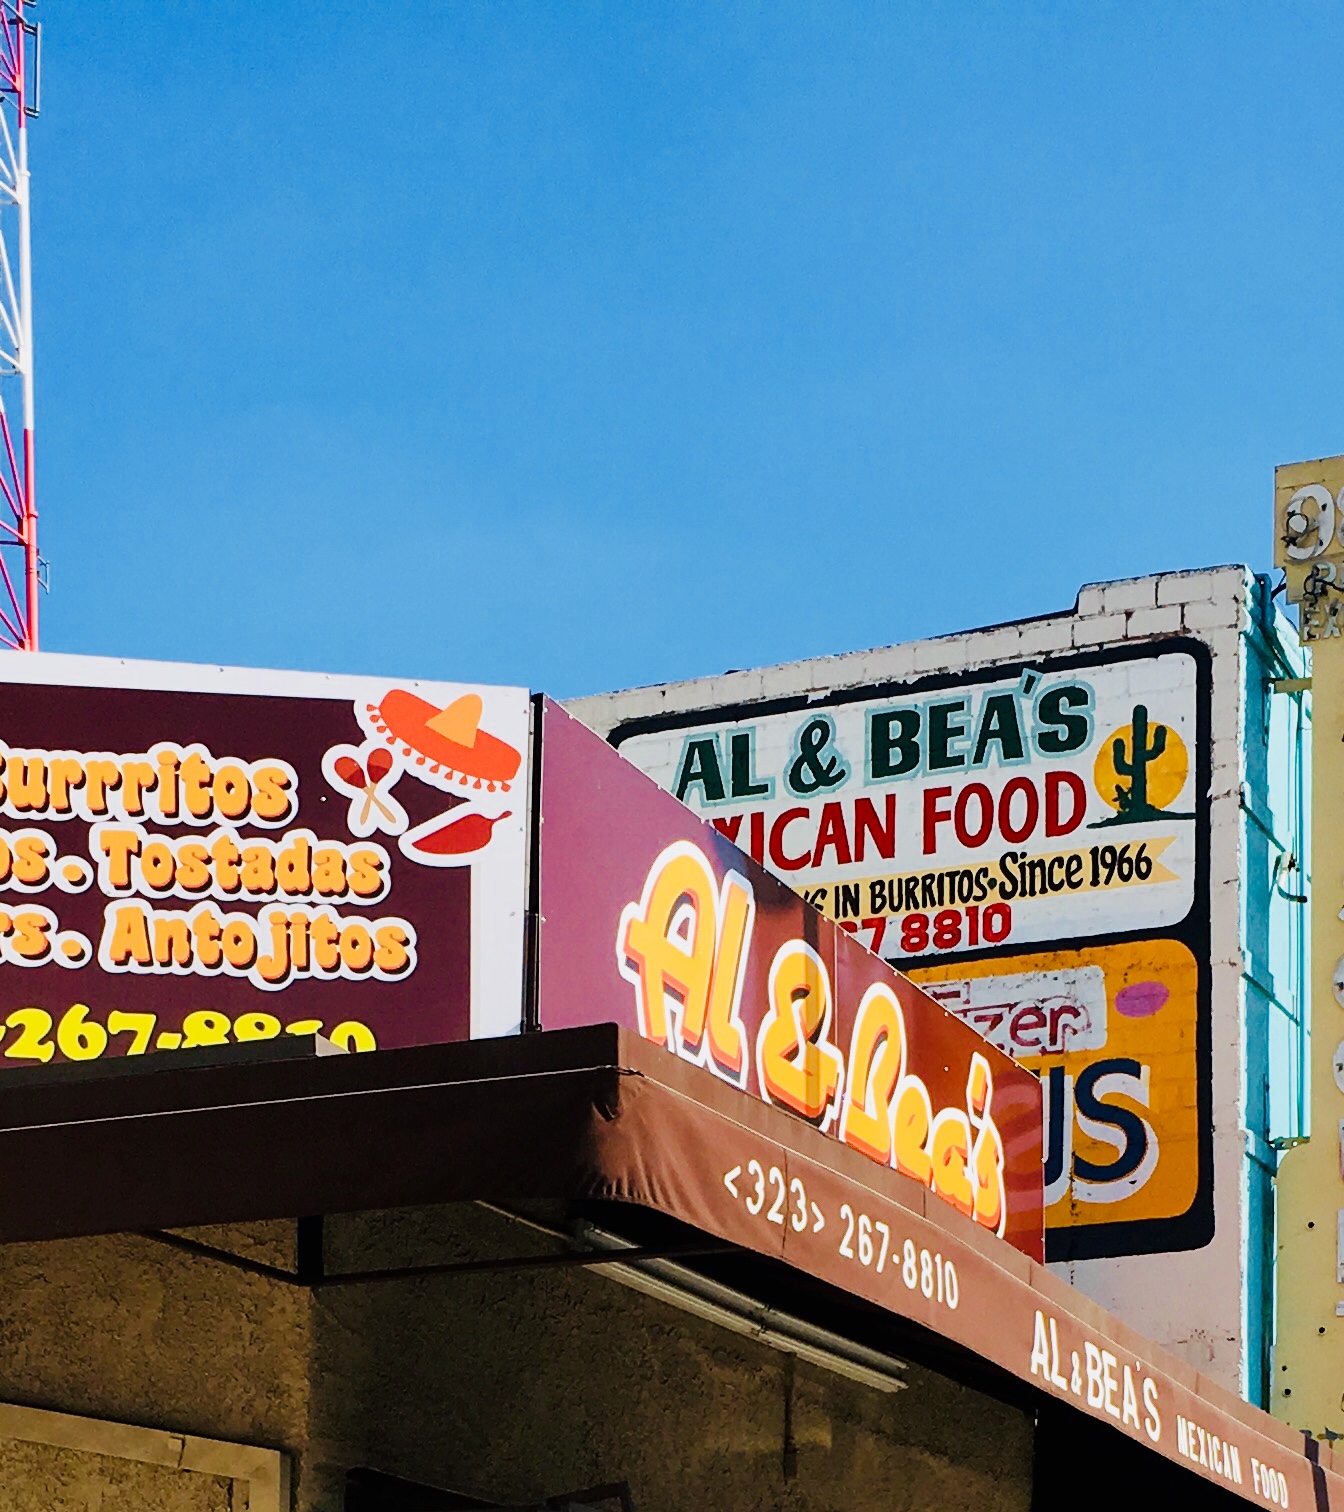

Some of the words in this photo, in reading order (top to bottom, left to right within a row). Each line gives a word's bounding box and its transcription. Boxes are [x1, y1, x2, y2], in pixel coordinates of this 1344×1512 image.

[675, 730, 769, 801] AL
[787, 717, 847, 790] &
[869, 670, 1093, 780] BEA'S
[922, 770, 1087, 855] FOOD
[97, 828, 386, 901] Tostadas
[834, 883, 860, 920] IN
[1089, 842, 1153, 888] 1966
[107, 908, 414, 986] Antojitos
[900, 902, 1012, 953] 8810
[618, 841, 753, 1087] Al
[758, 940, 842, 1130] &
[843, 980, 1006, 1238] Bea's
[838, 1203, 958, 1310] 267-8810
[1030, 1309, 1068, 1391] AL
[1070, 1349, 1083, 1397] &
[1083, 1339, 1162, 1443] BEA'S
[1175, 1413, 1243, 1485] MEXICAN
[1250, 1456, 1290, 1510] FOOD
